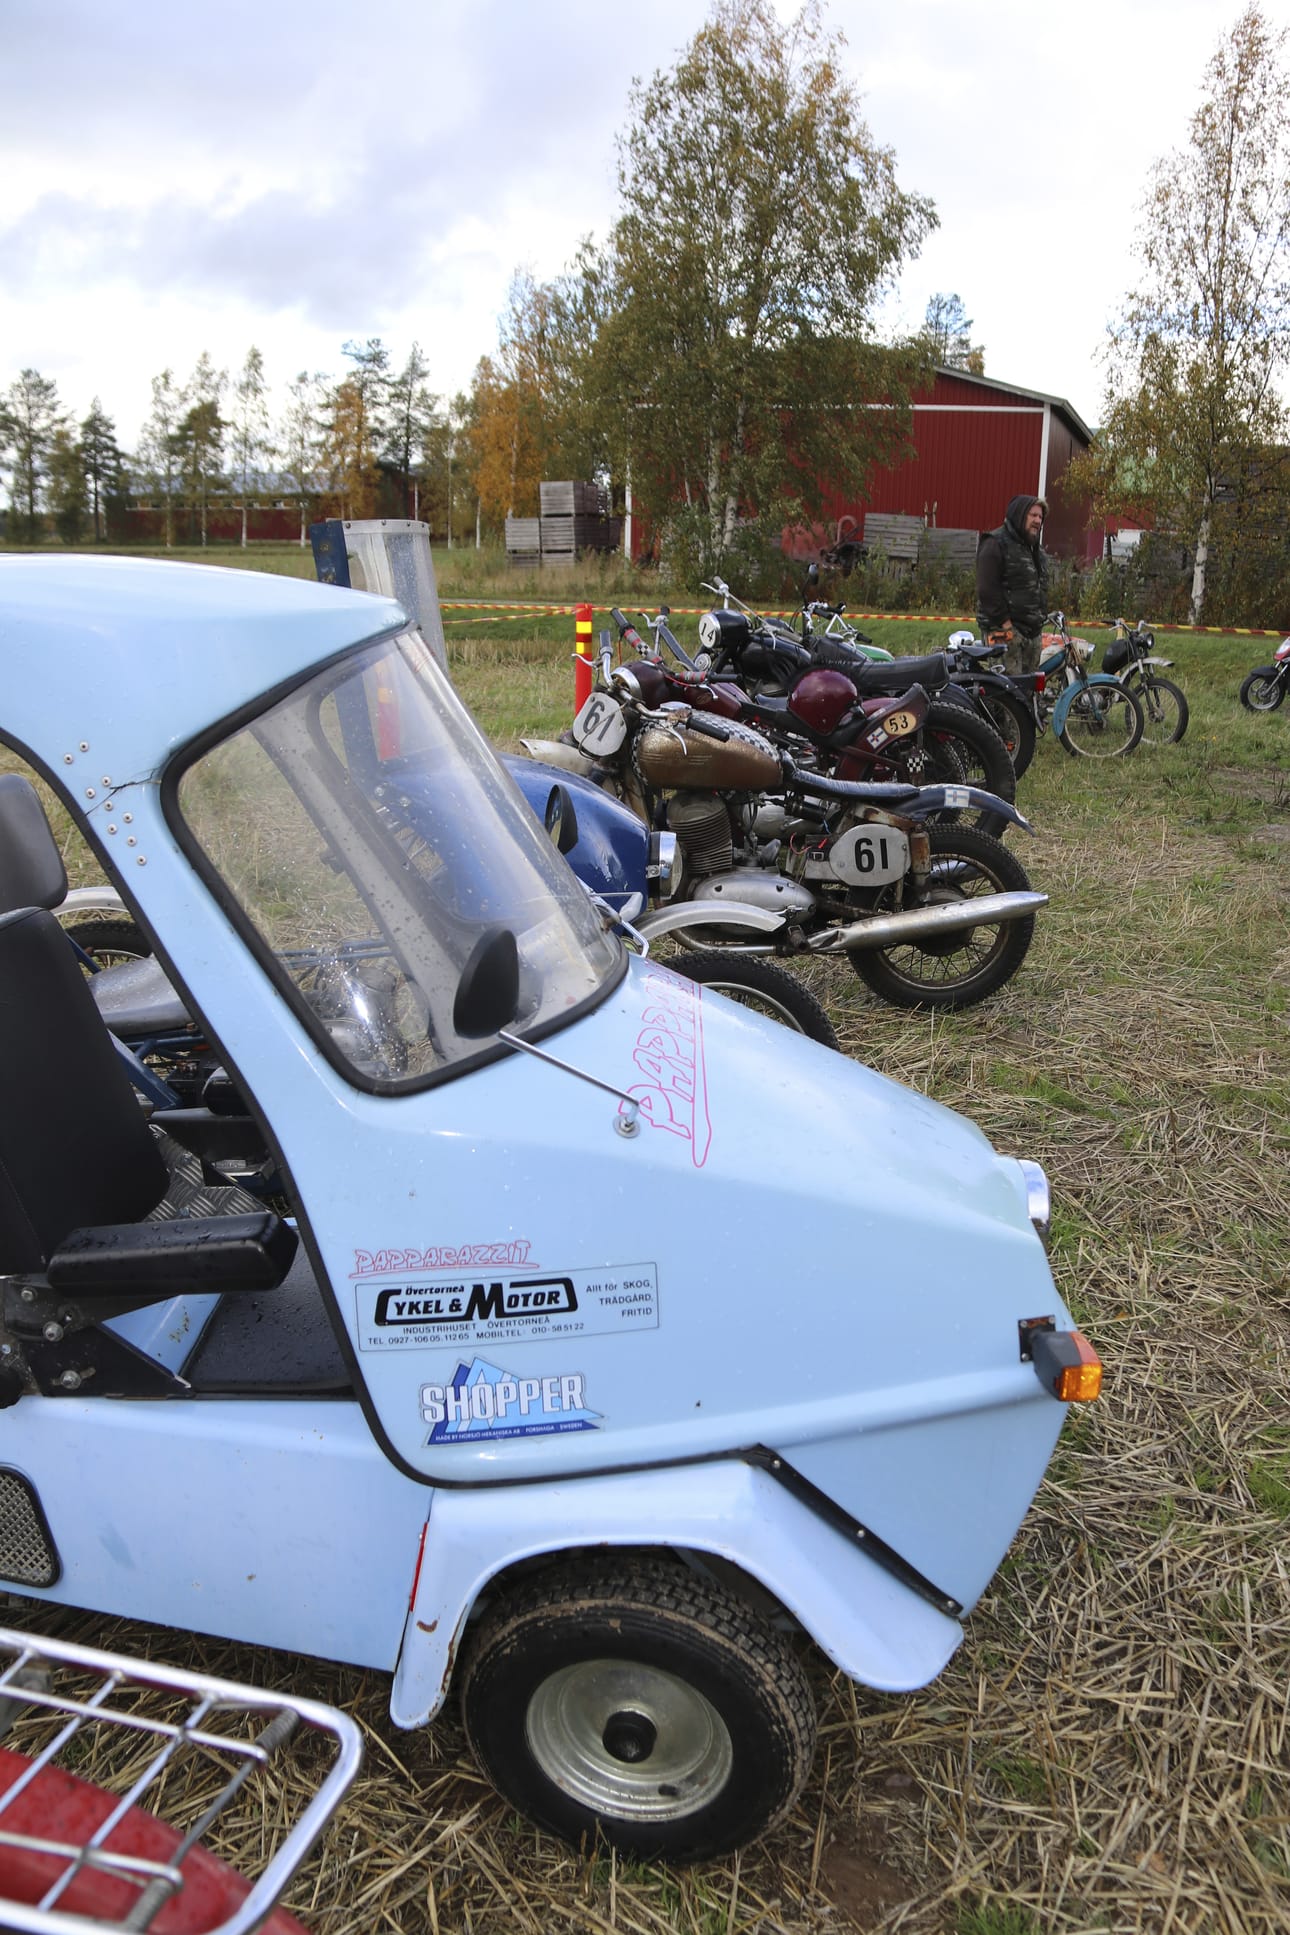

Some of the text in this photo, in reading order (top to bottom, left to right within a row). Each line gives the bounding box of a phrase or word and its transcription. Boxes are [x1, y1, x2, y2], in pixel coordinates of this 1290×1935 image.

[701, 622, 715, 642] 14
[583, 701, 616, 742] 61
[889, 715, 908, 732] 53
[854, 838, 888, 872] 61
[586, 1284, 602, 1293] Allt
[605, 1282, 617, 1291] för
[374, 1289, 444, 1326] CYKEL
[448, 1298, 462, 1312] &
[621, 1307, 652, 1318] FRITID
[403, 1323, 476, 1334] INDUSTRIHUSET
[421, 1374, 585, 1423] SHOPPER
